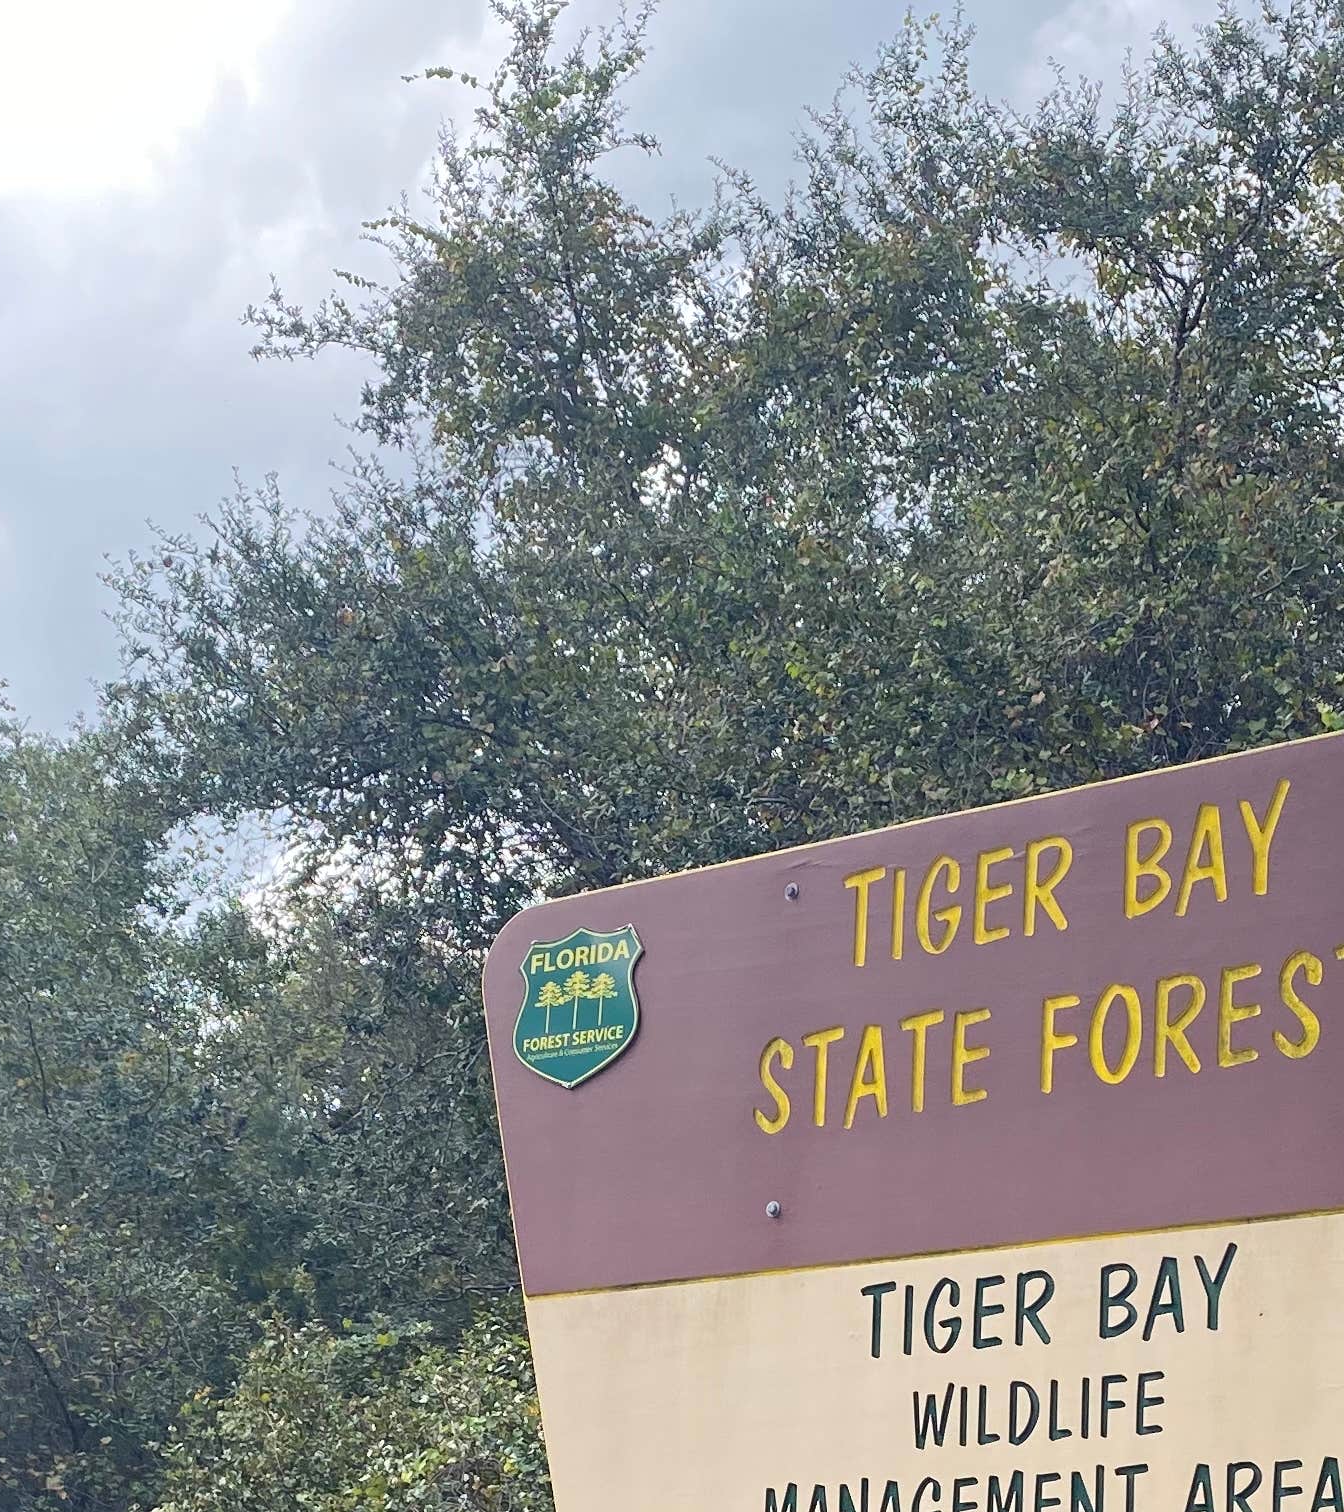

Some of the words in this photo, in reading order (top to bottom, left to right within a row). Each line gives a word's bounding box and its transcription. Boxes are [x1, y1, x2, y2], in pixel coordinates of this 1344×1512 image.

[843, 835, 1073, 966] TIGER
[1125, 778, 1291, 919] BAY
[531, 940, 630, 973] FLORIDA
[523, 1033, 571, 1053] FOREST
[572, 1025, 624, 1046] SERVICE
[753, 1007, 992, 1135] STATE
[860, 1269, 1056, 1358] TIGER
[1099, 1242, 1238, 1342] BAY
[912, 1371, 1165, 1449] WILDLIFE
